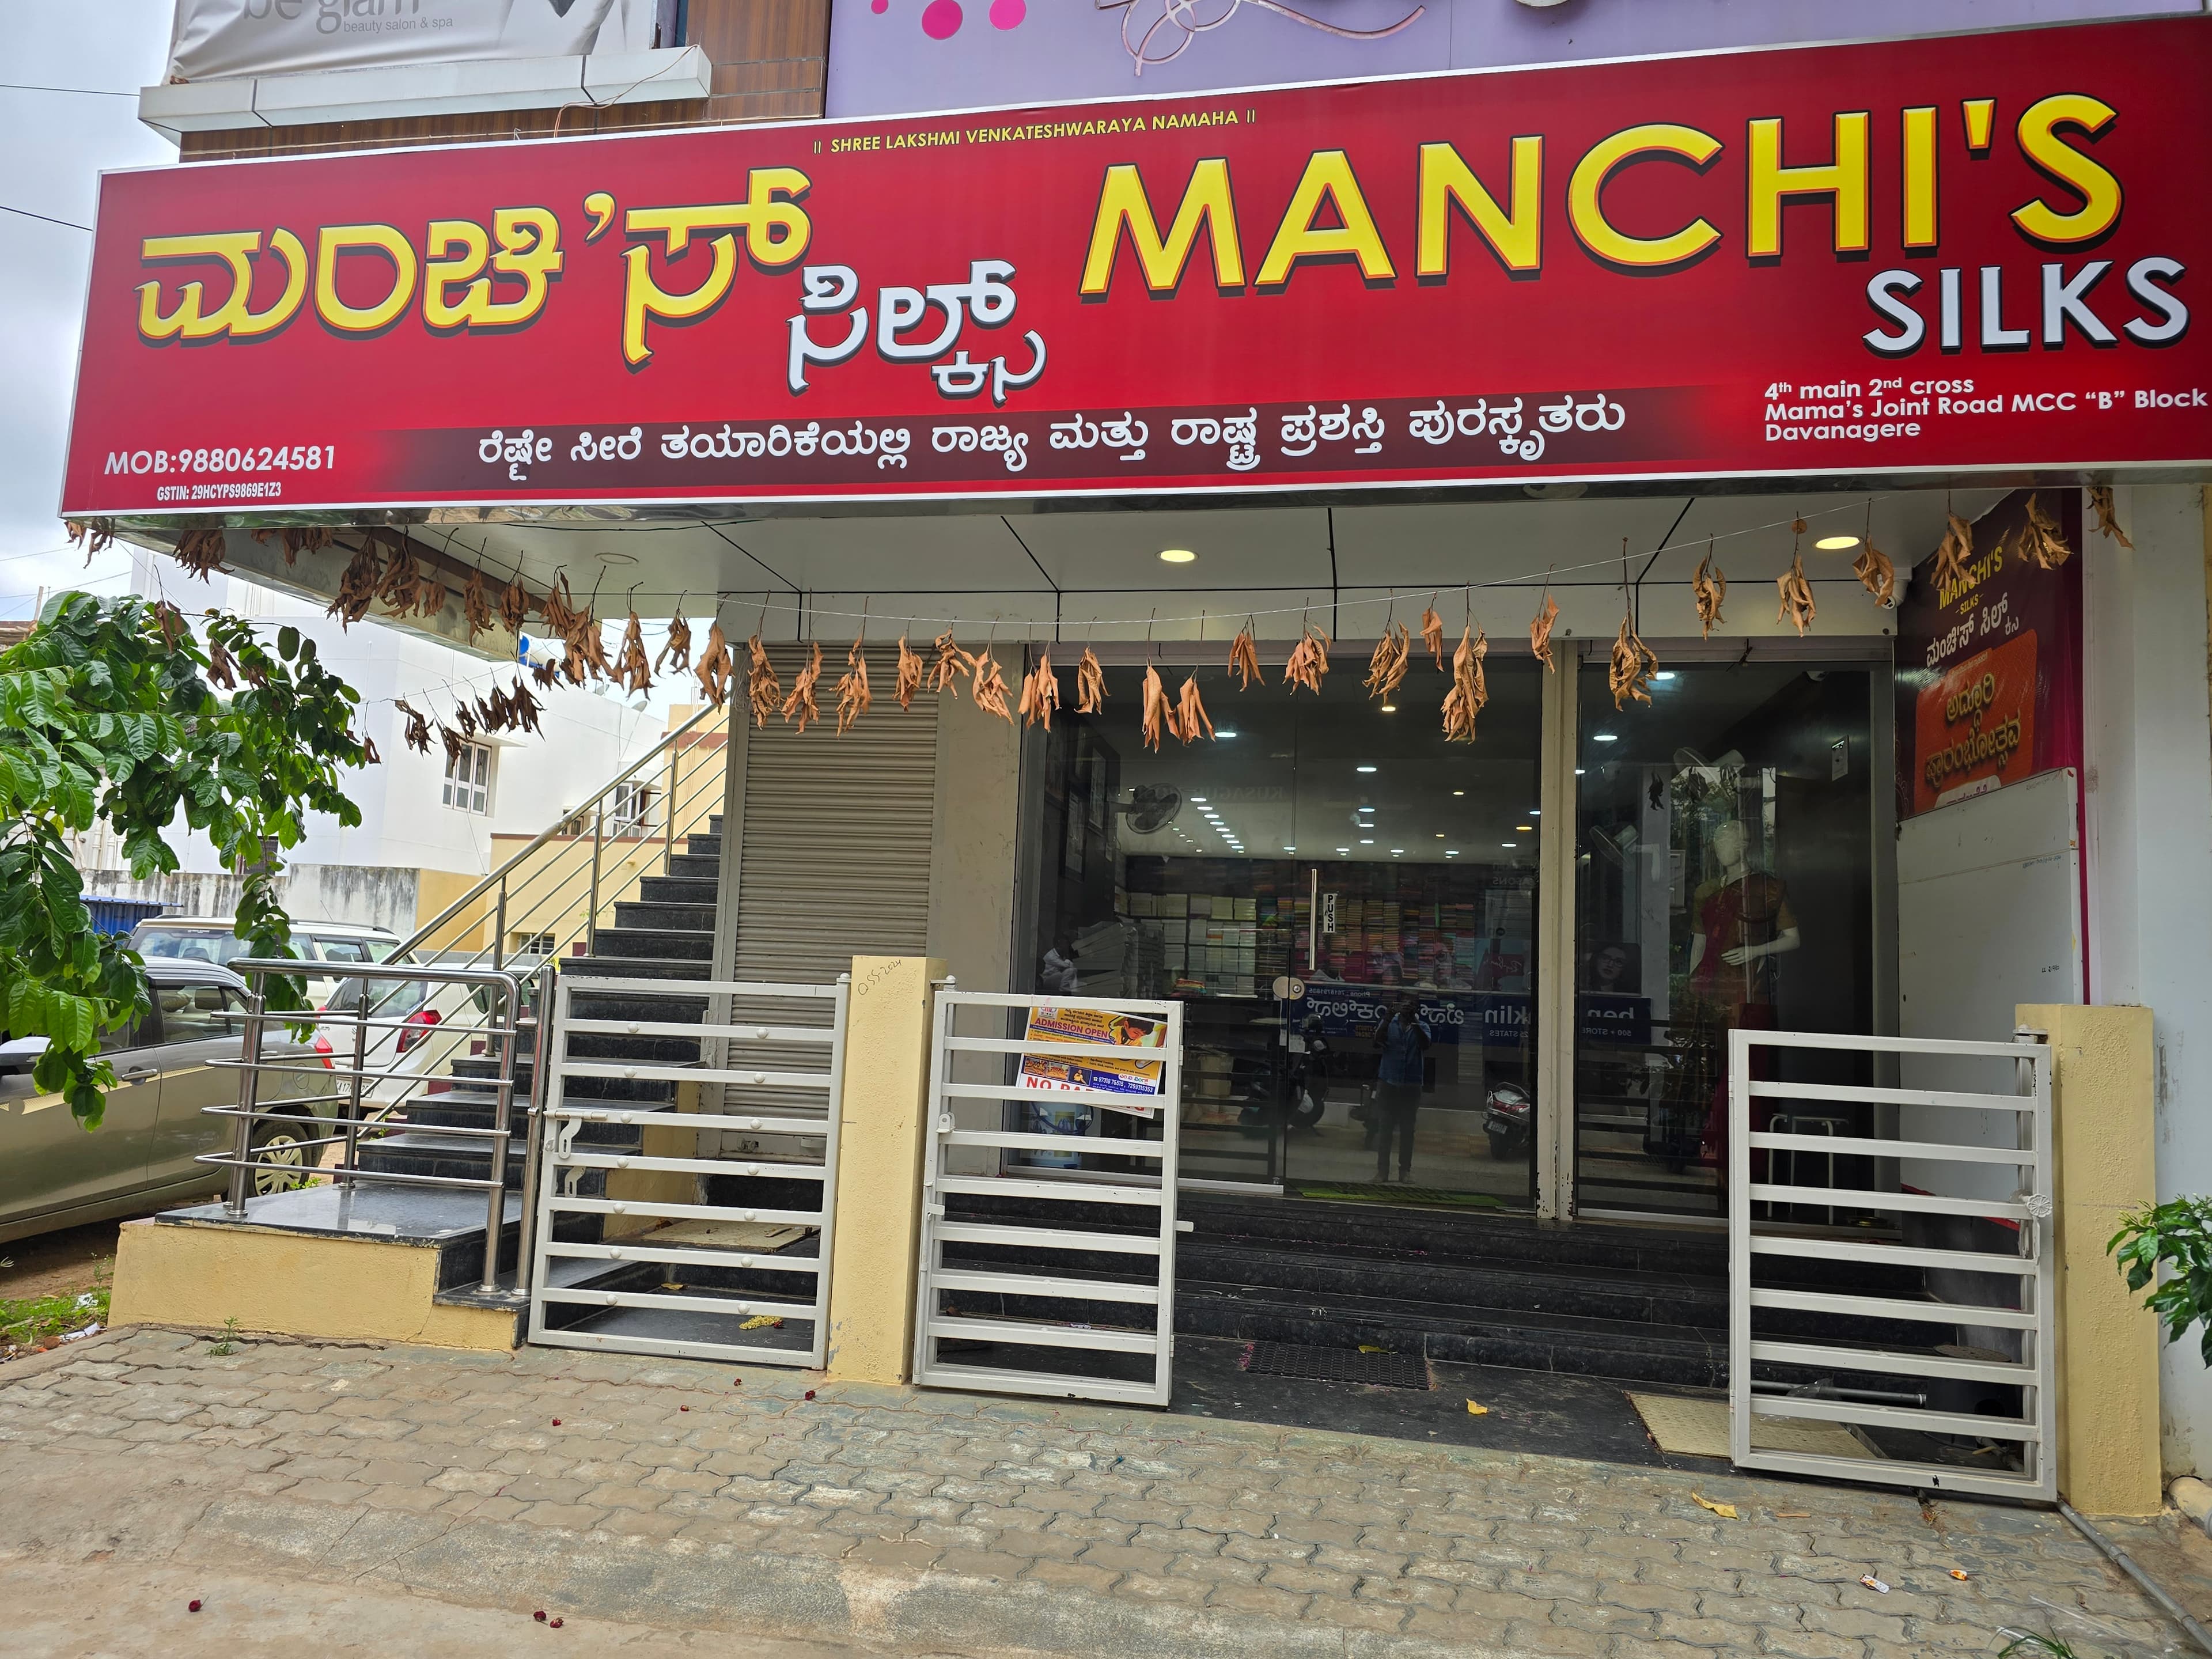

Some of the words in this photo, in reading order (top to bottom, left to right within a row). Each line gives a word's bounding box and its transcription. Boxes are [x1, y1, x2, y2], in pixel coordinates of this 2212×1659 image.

[343, 20, 382, 34] beauty
[385, 18, 416, 31] salon
[419, 17, 429, 28] &
[431, 17, 453, 30] spa
[831, 135, 881, 153] SHREE
[885, 130, 961, 150] LAKSHMI
[965, 117, 1147, 144] VENKATESHWARAYA
[1152, 109, 1240, 130] NAMAHA
[1078, 93, 2122, 295] MANCHI'S
[1862, 256, 2189, 353] SILKS
[1764, 381, 1793, 400] 4th
[1799, 379, 1861, 399] main
[1868, 377, 1903, 396] 2nd
[1909, 378, 1975, 395] cross
[1870, 397, 1930, 418] Joint
[1937, 394, 2003, 415] Road
[2010, 392, 2077, 412] MCC
[2134, 387, 2209, 409] Block
[570, 426, 643, 461] ಸೀರೆ
[660, 420, 911, 469] ತಯಾರಿಕೆಯಲ್ಲಿ
[931, 425, 1029, 472] ರಾಜ್ಯ
[1049, 411, 1149, 461] ಮತ್ತು
[1170, 407, 1262, 472] ರಾಷ್ಟ್ರ
[1280, 403, 1385, 457] ಪ್ರಶಸ್ತಿ
[1408, 393, 1626, 461] ಪುರಸ್ಕೃತರು
[1765, 422, 1921, 442] Davanagere
[104, 445, 335, 476] MOB:9880624581
[156, 486, 190, 502] GSTIN:
[191, 480, 282, 500] 29HCYPS9869E1Z3
[1960, 593, 1979, 615] SILKS
[1326, 893, 1335, 933] PUSH
[1035, 1017, 1084, 1033] ADMISSION
[1085, 1027, 1108, 1039] OPEN
[1026, 1076, 1052, 1089] NO
